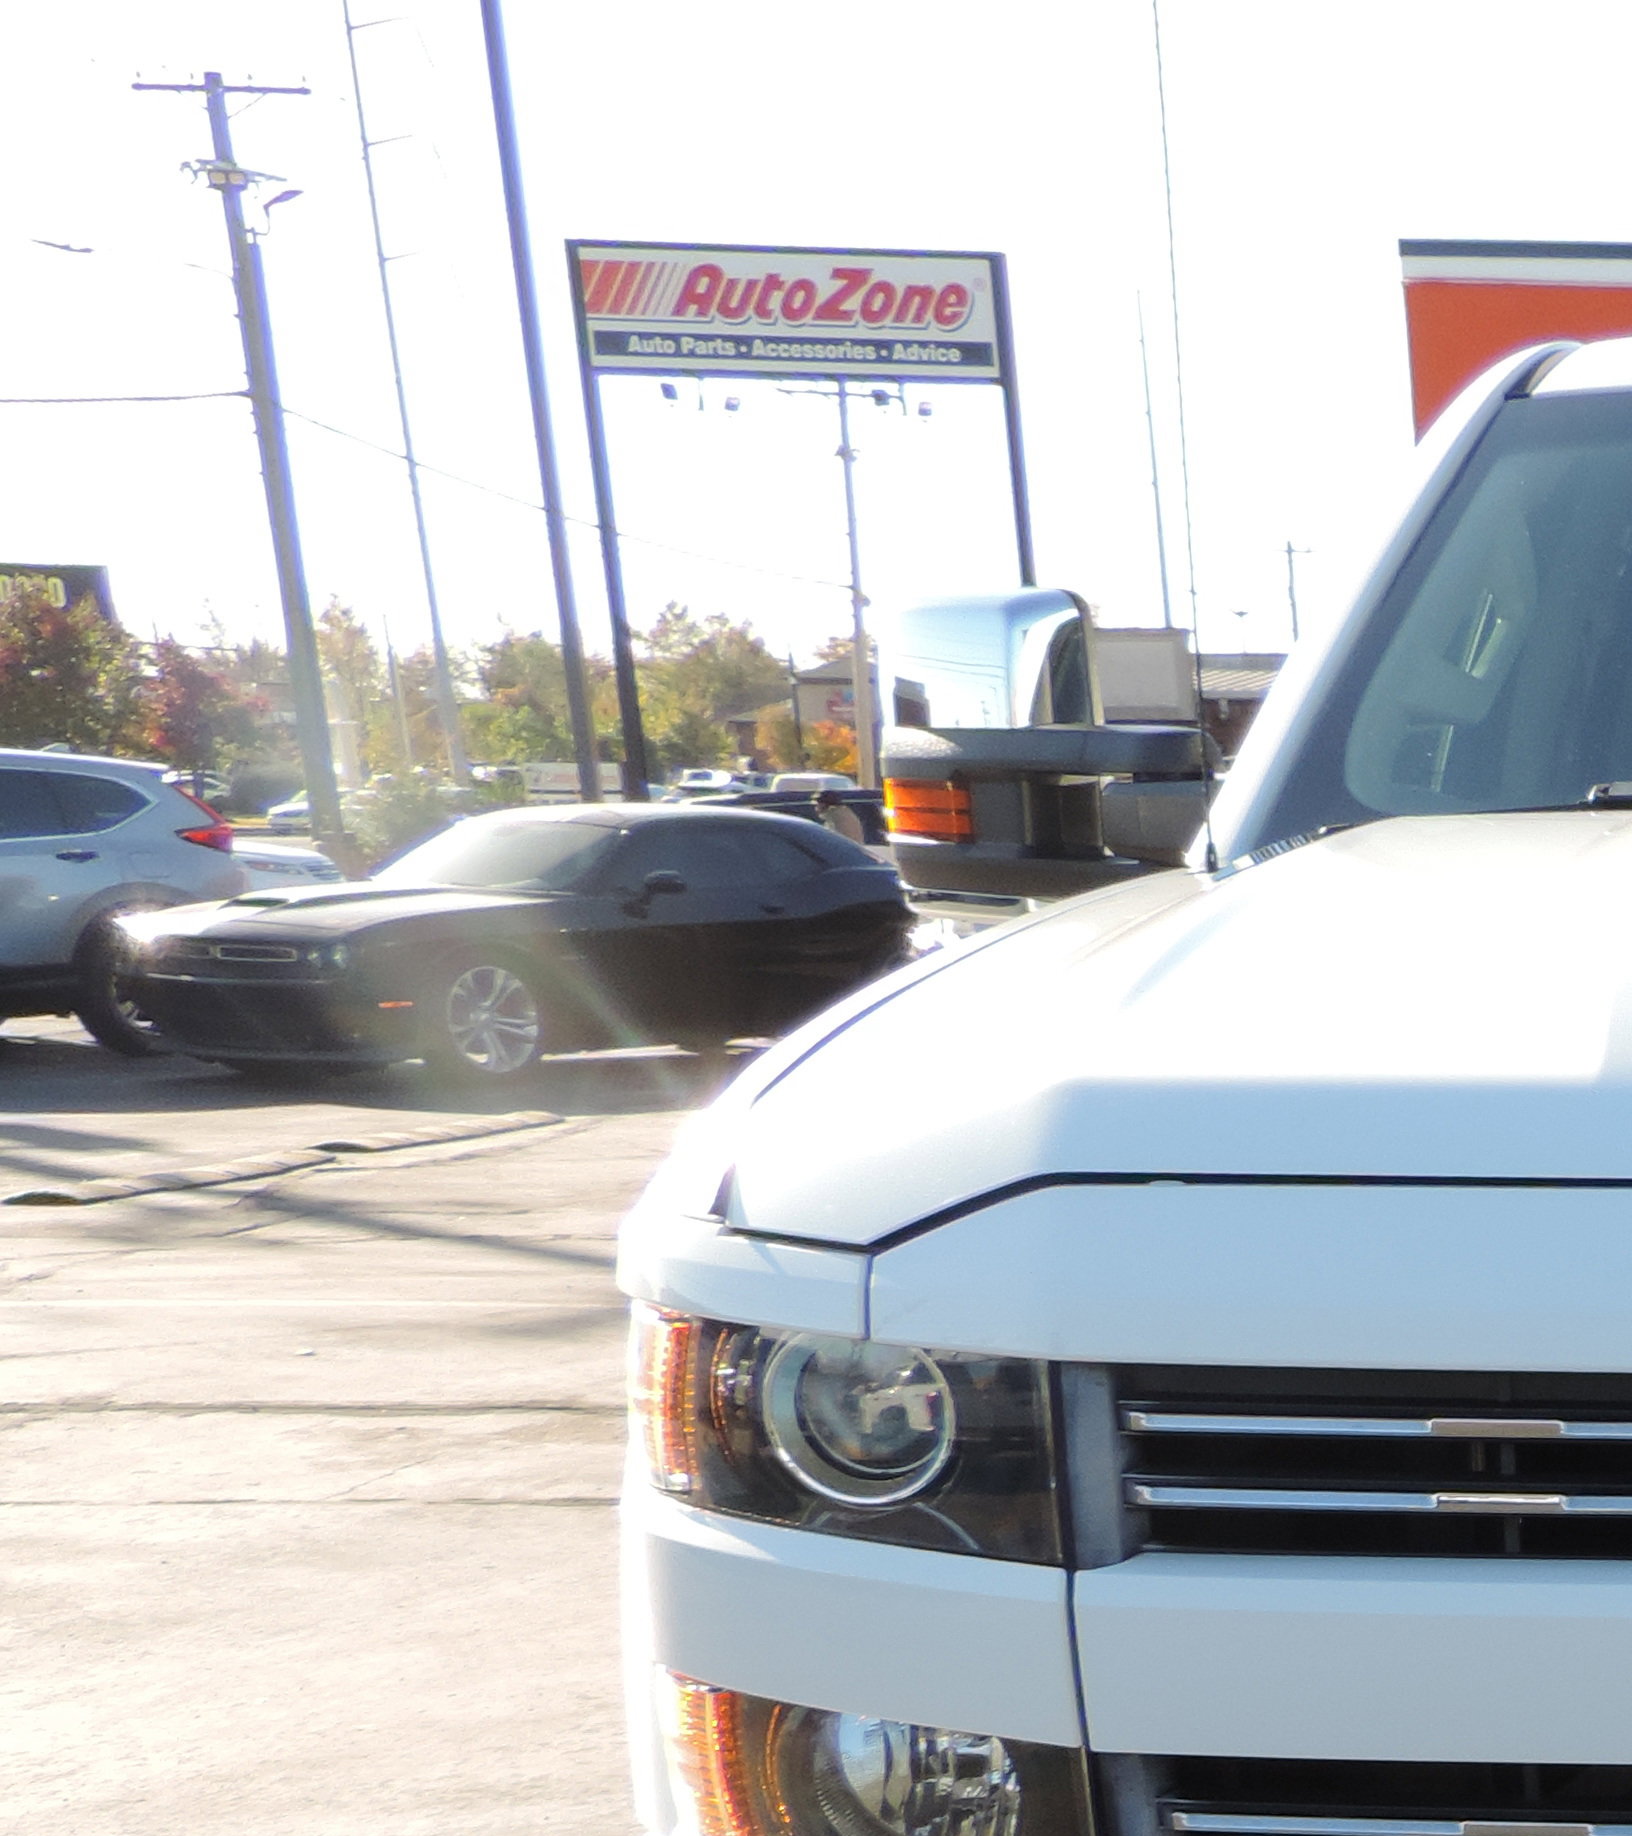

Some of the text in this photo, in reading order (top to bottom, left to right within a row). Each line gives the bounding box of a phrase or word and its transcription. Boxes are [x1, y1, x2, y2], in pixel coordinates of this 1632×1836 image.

[671, 263, 972, 328] AutoZone
[628, 335, 962, 362] Auto Parts Accessories Advice
